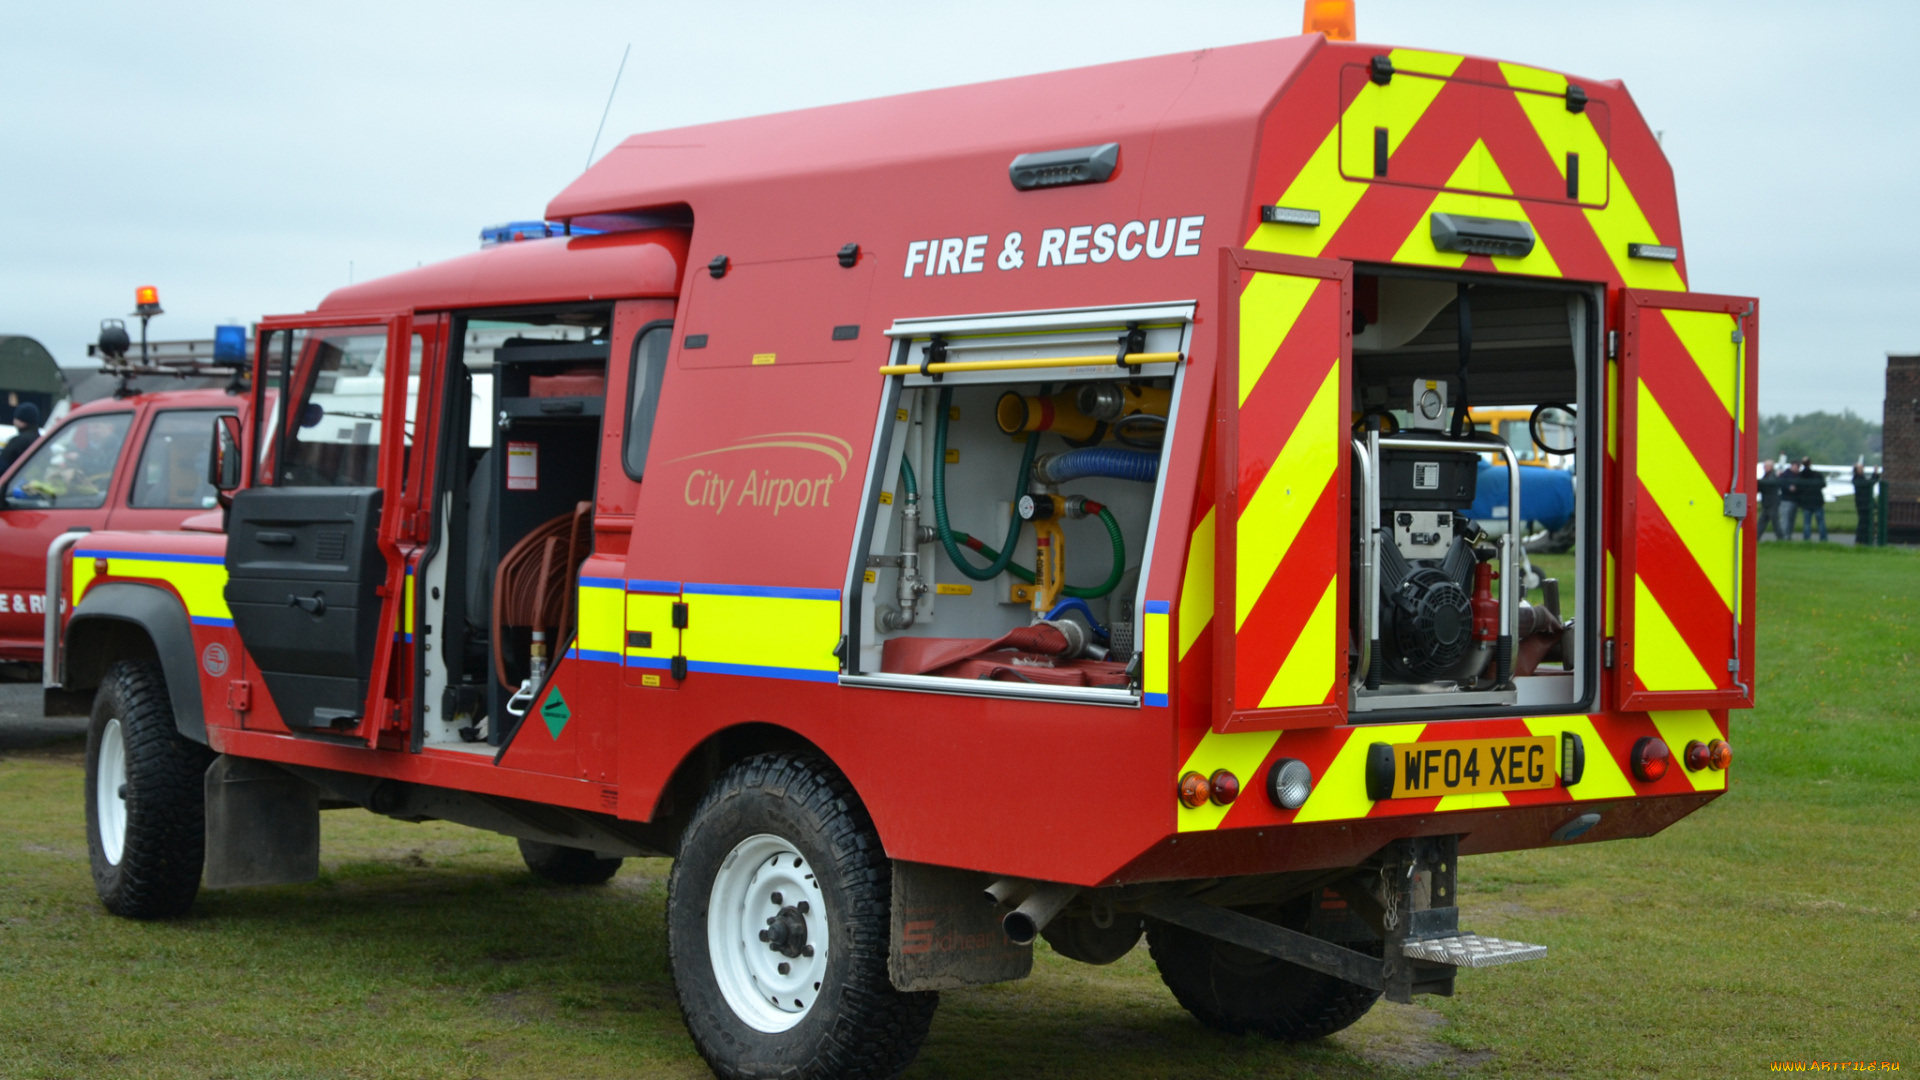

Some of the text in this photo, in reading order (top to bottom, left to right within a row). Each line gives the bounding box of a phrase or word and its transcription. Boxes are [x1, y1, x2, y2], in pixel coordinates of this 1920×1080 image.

[902, 214, 1205, 278] FIRE & RESCUE
[684, 468, 834, 517] City Airport
[12, 593, 28, 613] &
[1404, 744, 1544, 791] WF04 XEG
